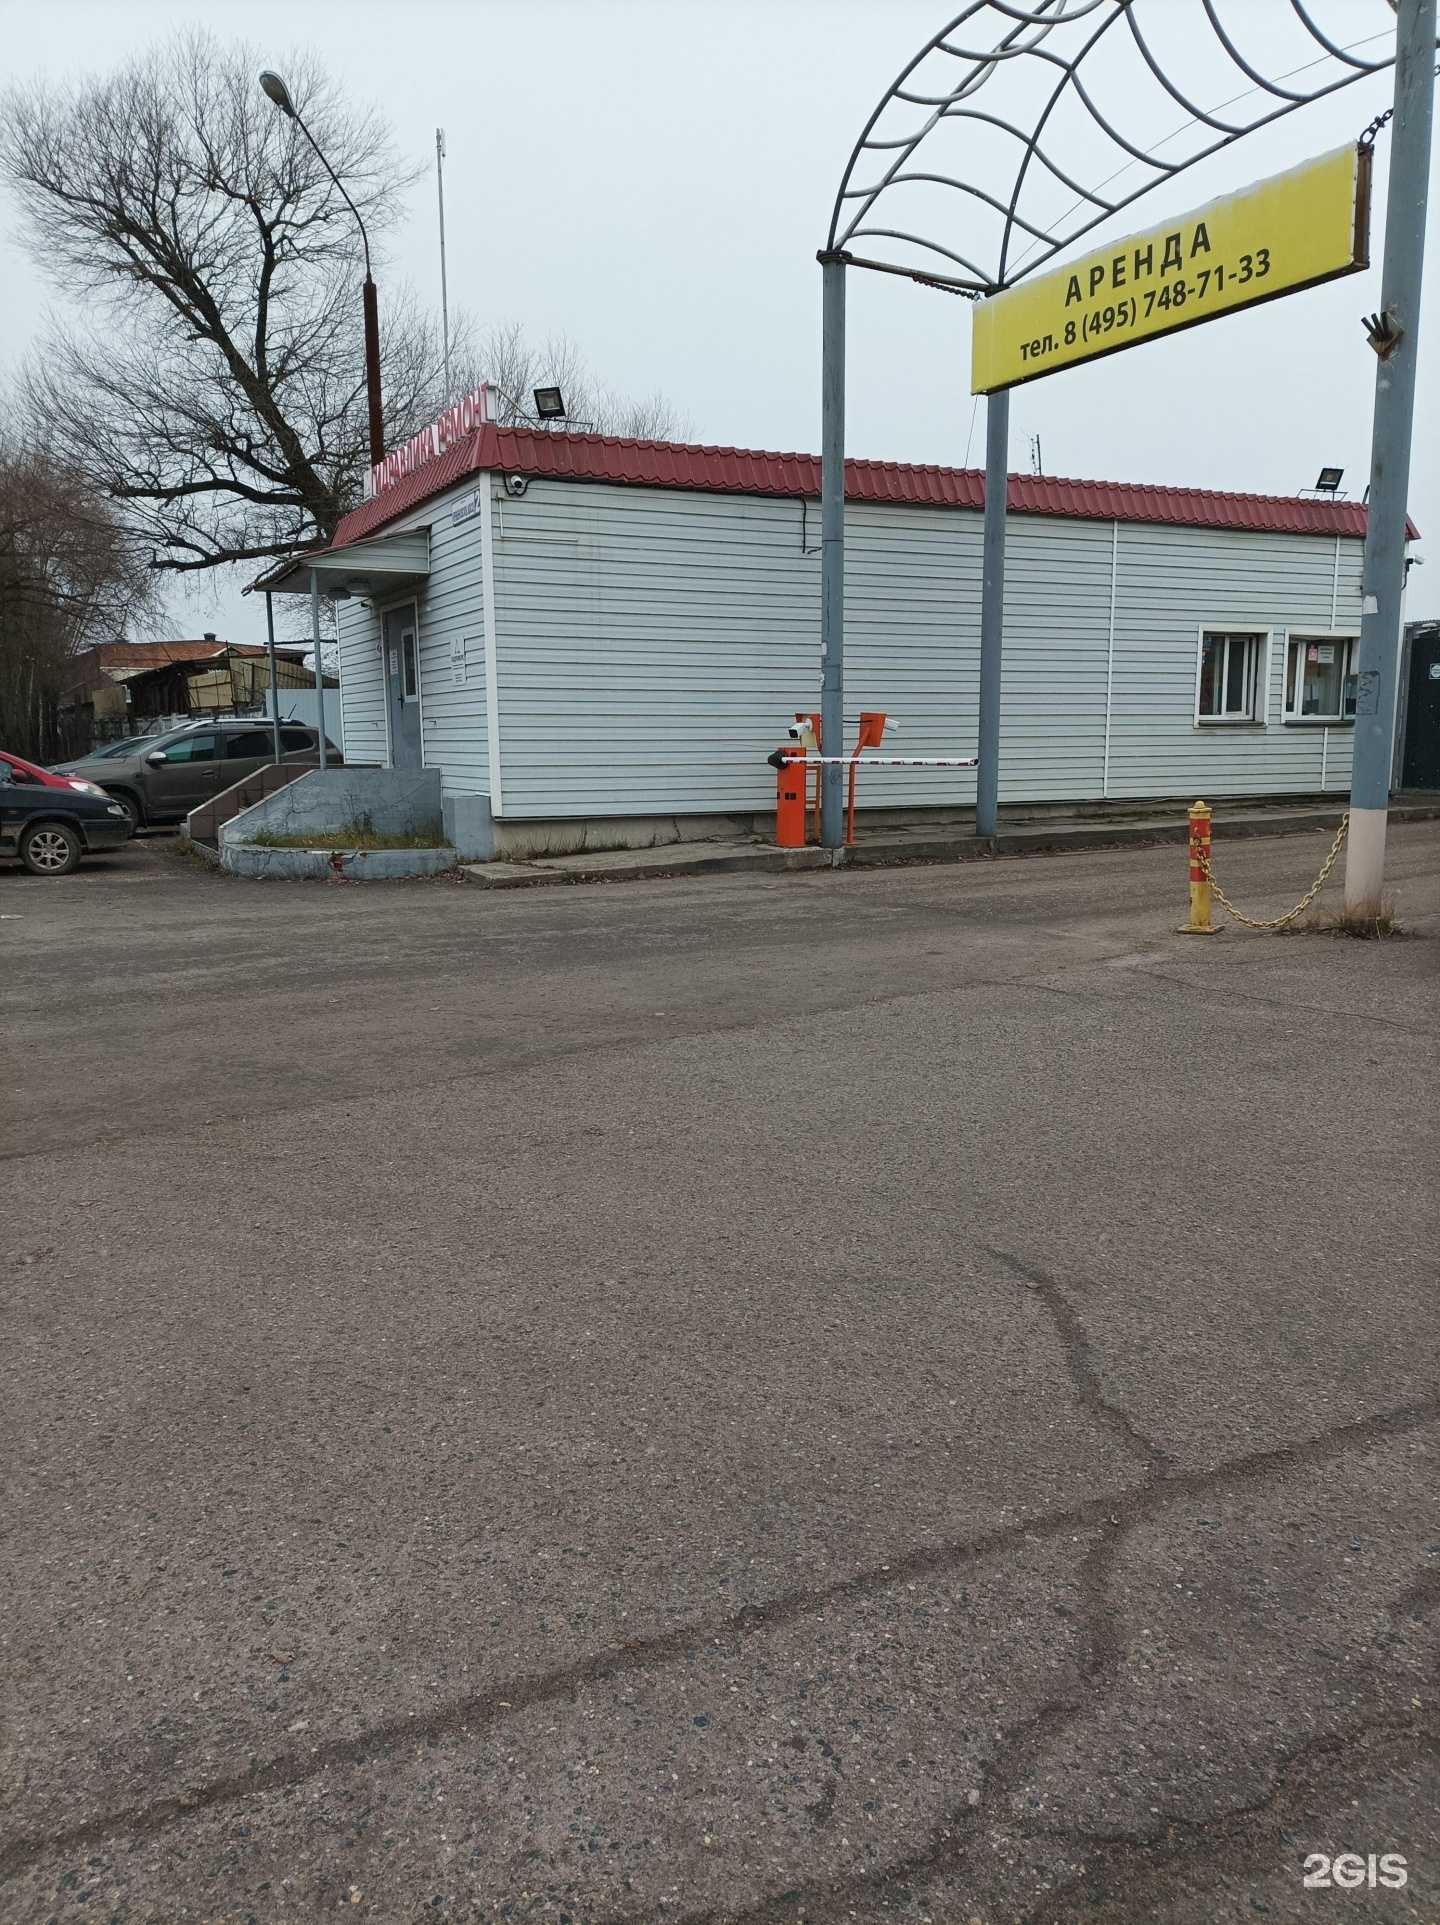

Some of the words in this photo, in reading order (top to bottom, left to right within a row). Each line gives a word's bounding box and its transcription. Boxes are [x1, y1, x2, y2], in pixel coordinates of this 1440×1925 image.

[1020, 334, 1058, 361] тел.
[1064, 321, 1077, 344] 8
[1082, 297, 1137, 342] (495)
[1143, 248, 1271, 319] 748-71-33
[1065, 222, 1211, 307] АРЕНДА
[437, 383, 491, 451] РЕМОНТ
